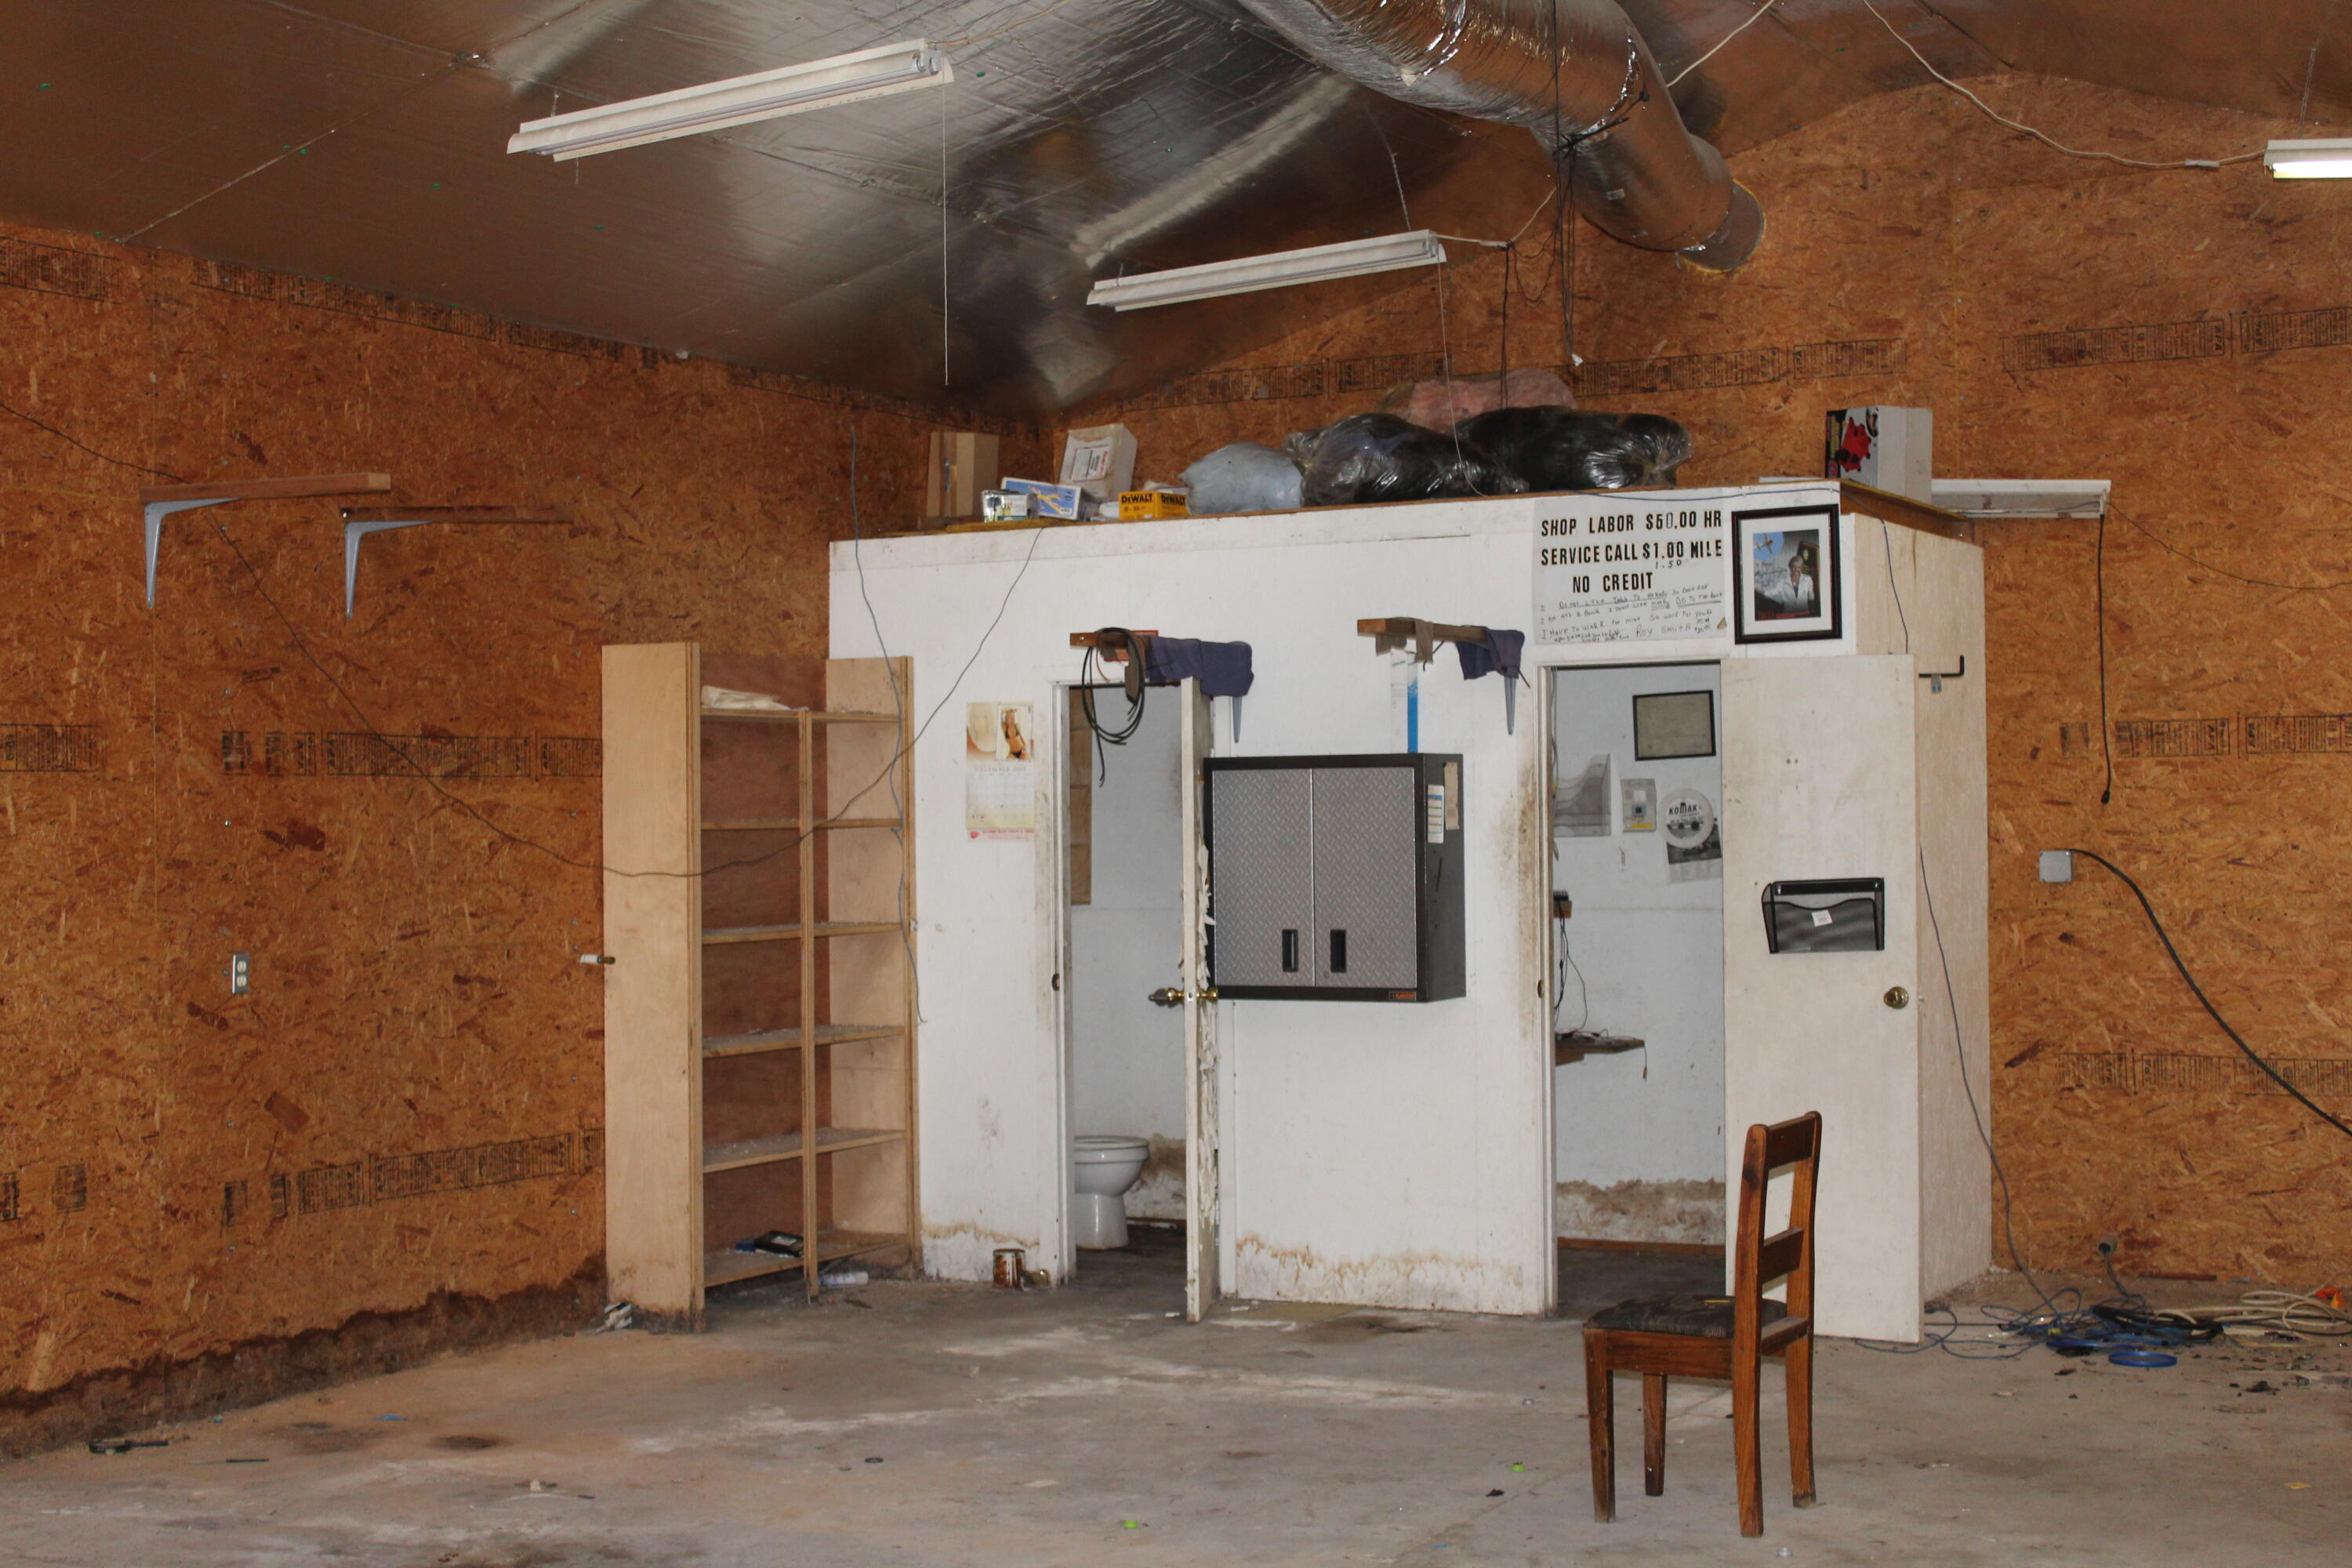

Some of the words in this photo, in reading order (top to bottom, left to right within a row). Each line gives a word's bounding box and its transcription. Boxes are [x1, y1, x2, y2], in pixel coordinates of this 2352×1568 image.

[1541, 518, 1577, 536] SHOP
[1588, 514, 1634, 533] LABOR
[1704, 510, 1722, 528] HR
[1541, 546, 1600, 566] SERVICE
[1606, 543, 1638, 562] CALL
[1690, 539, 1722, 558] MILE
[1655, 559, 1682, 569] 1.50
[1573, 575, 1590, 593] NO
[1602, 572, 1653, 592] CREDIT
[1669, 803, 1697, 815] KODIAK
